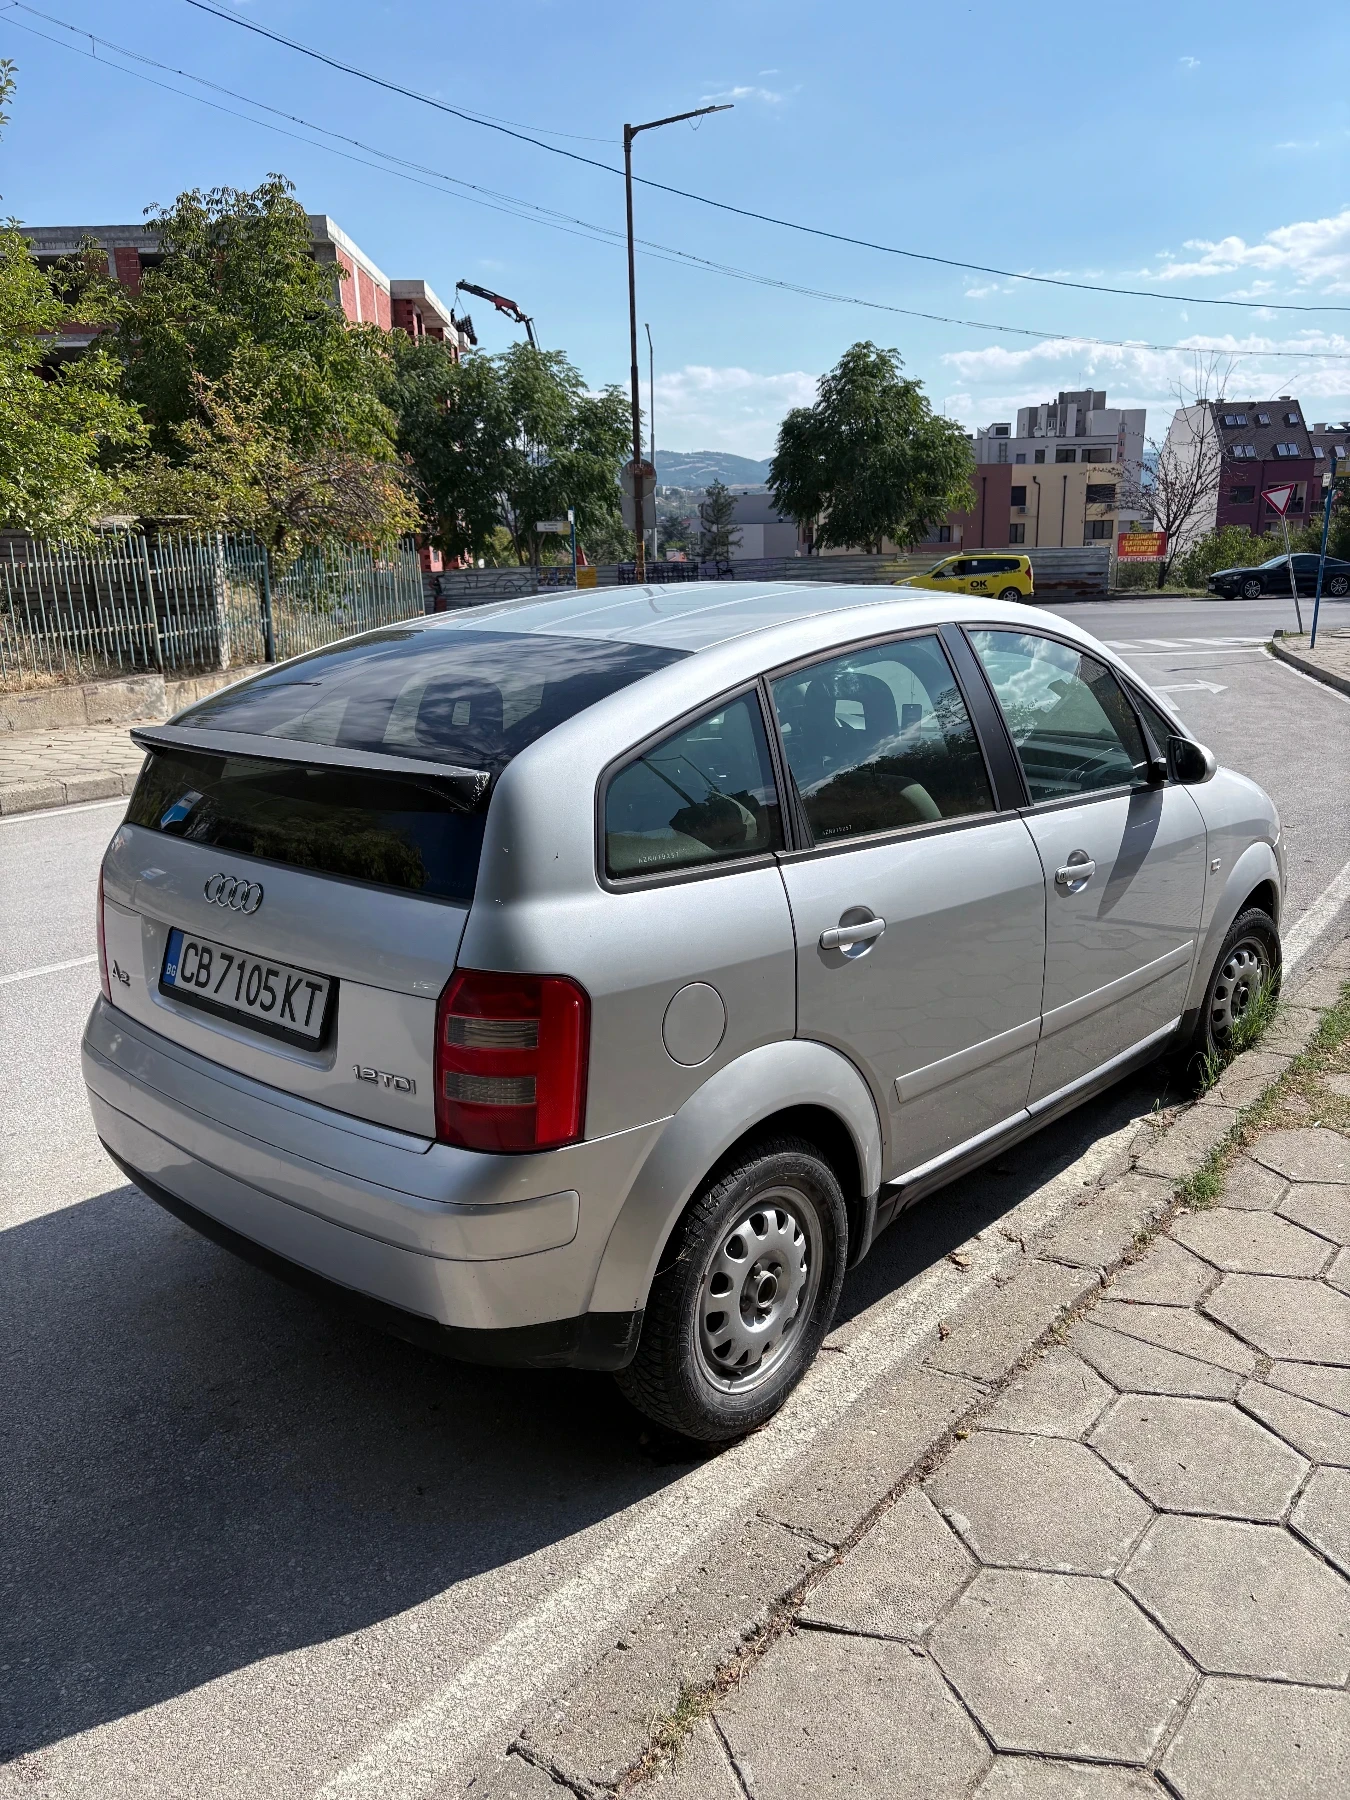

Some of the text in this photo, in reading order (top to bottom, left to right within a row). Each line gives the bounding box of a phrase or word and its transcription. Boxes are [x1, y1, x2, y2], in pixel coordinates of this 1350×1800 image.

[112, 959, 131, 987] A2
[166, 963, 177, 977] BG
[213, 952, 280, 1012] 7105
